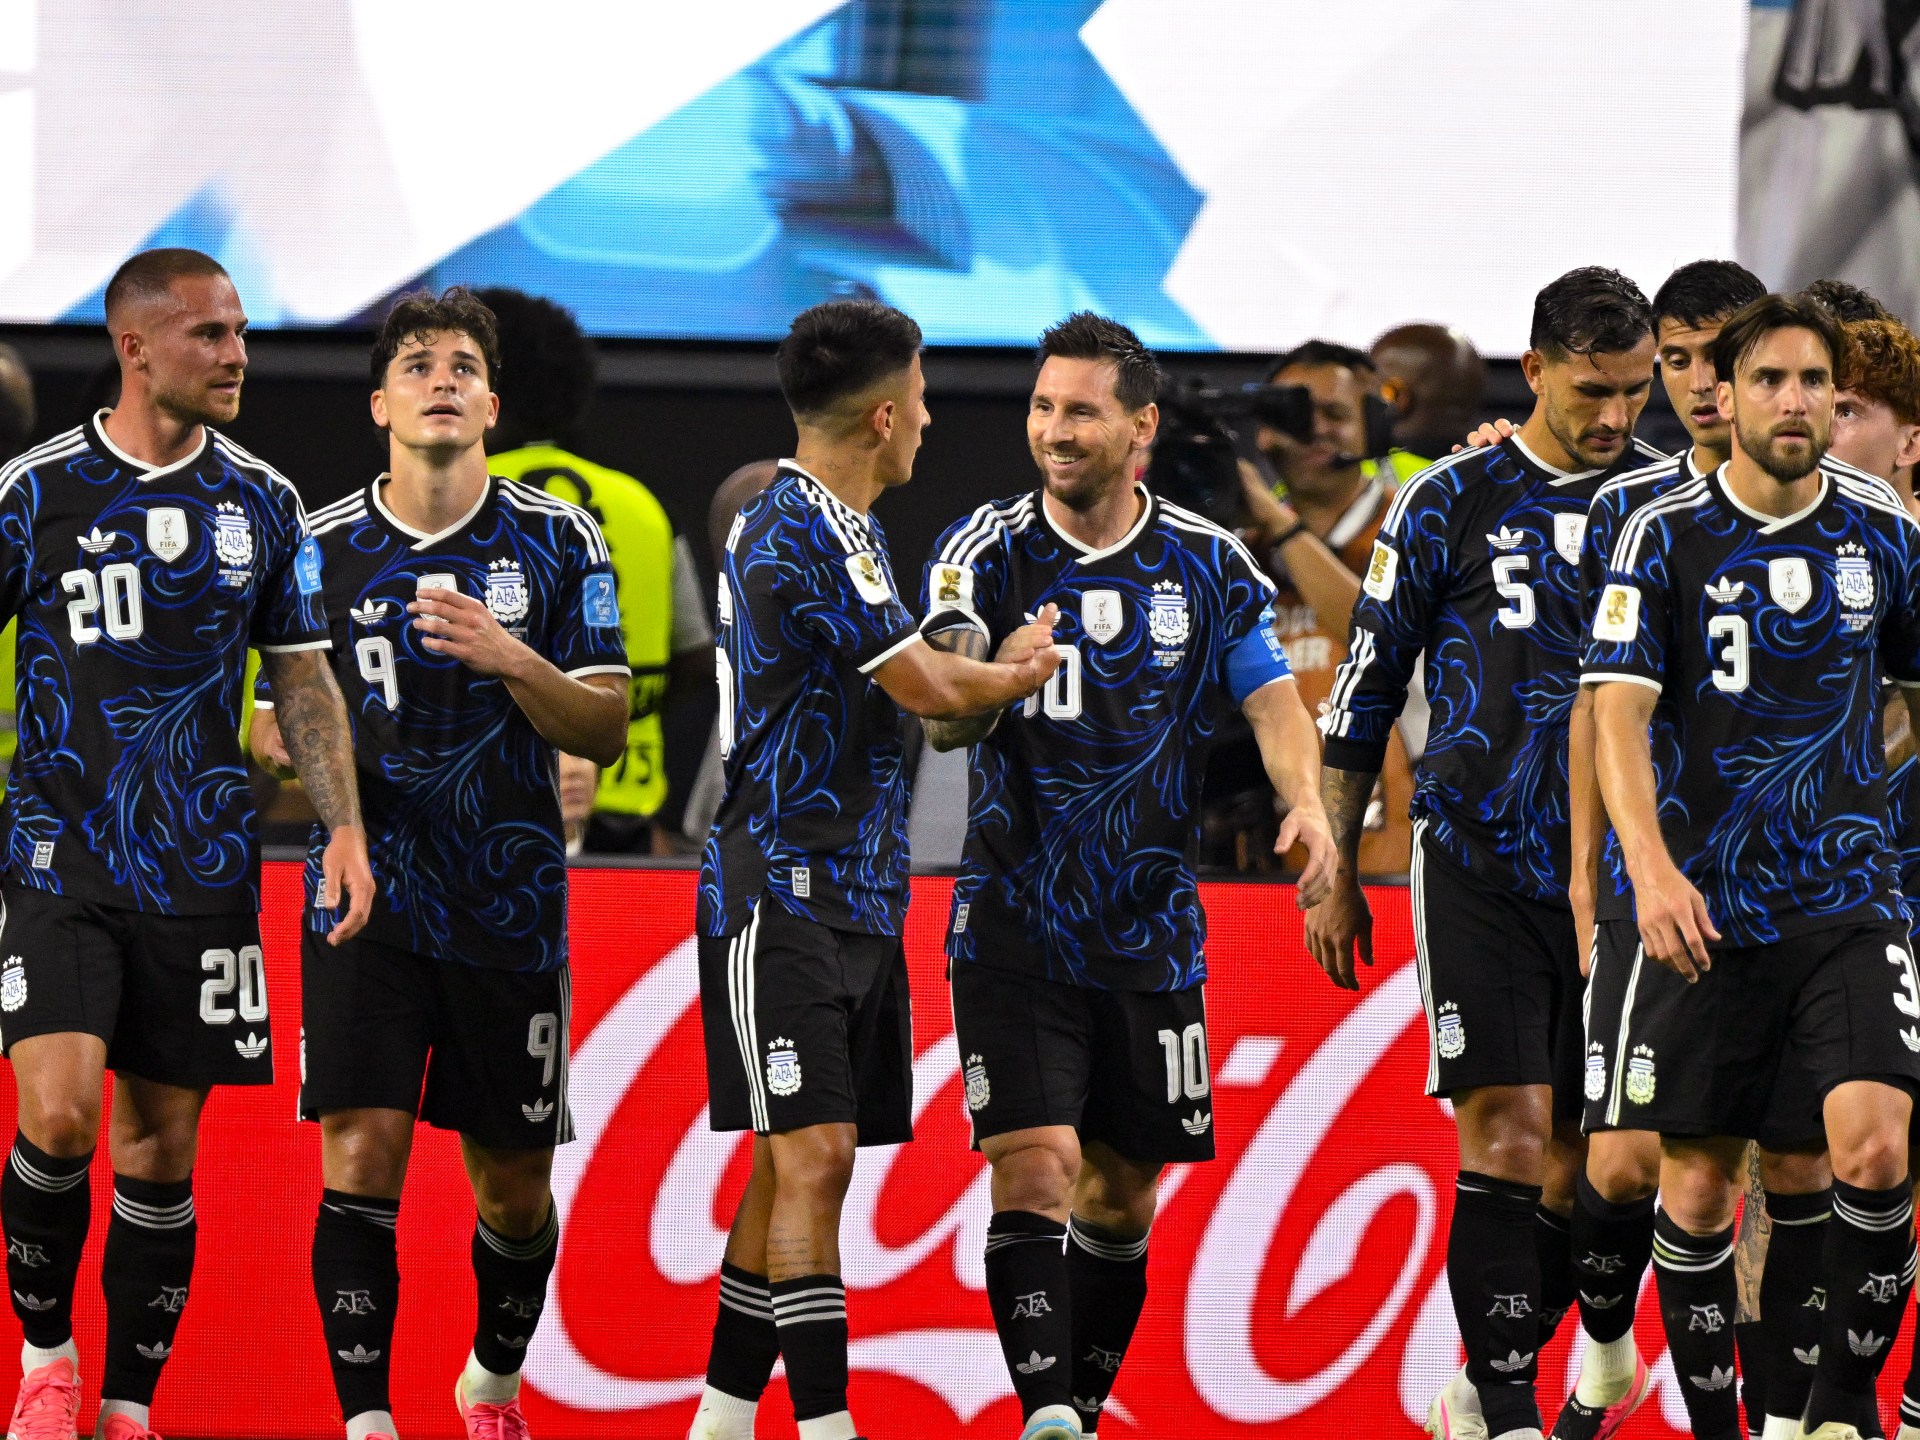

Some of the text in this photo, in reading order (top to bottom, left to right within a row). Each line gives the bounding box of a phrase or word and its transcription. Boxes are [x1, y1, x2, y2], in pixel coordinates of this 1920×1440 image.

[224, 528, 245, 551] AFA
[494, 585, 519, 606] AFA
[1491, 554, 1536, 629] 5
[1846, 571, 1866, 593] AFA
[60, 562, 144, 644] 20
[1159, 608, 1180, 630] AFA
[1708, 614, 1750, 693] 3
[355, 636, 399, 712] 9
[1023, 644, 1082, 720] 0
[199, 944, 268, 1024] 20
[1886, 943, 1920, 1019] 3
[526, 1012, 558, 1088] 9
[1158, 1022, 1209, 1104] 10
[774, 1063, 793, 1082] AFA
[8, 1236, 50, 1267] AFA
[332, 1289, 376, 1315] AFA
[1858, 1272, 1898, 1304] AFA
[1011, 1291, 1052, 1320] AFA
[1486, 1293, 1532, 1318] AFA
[1688, 1303, 1725, 1334] AFA
